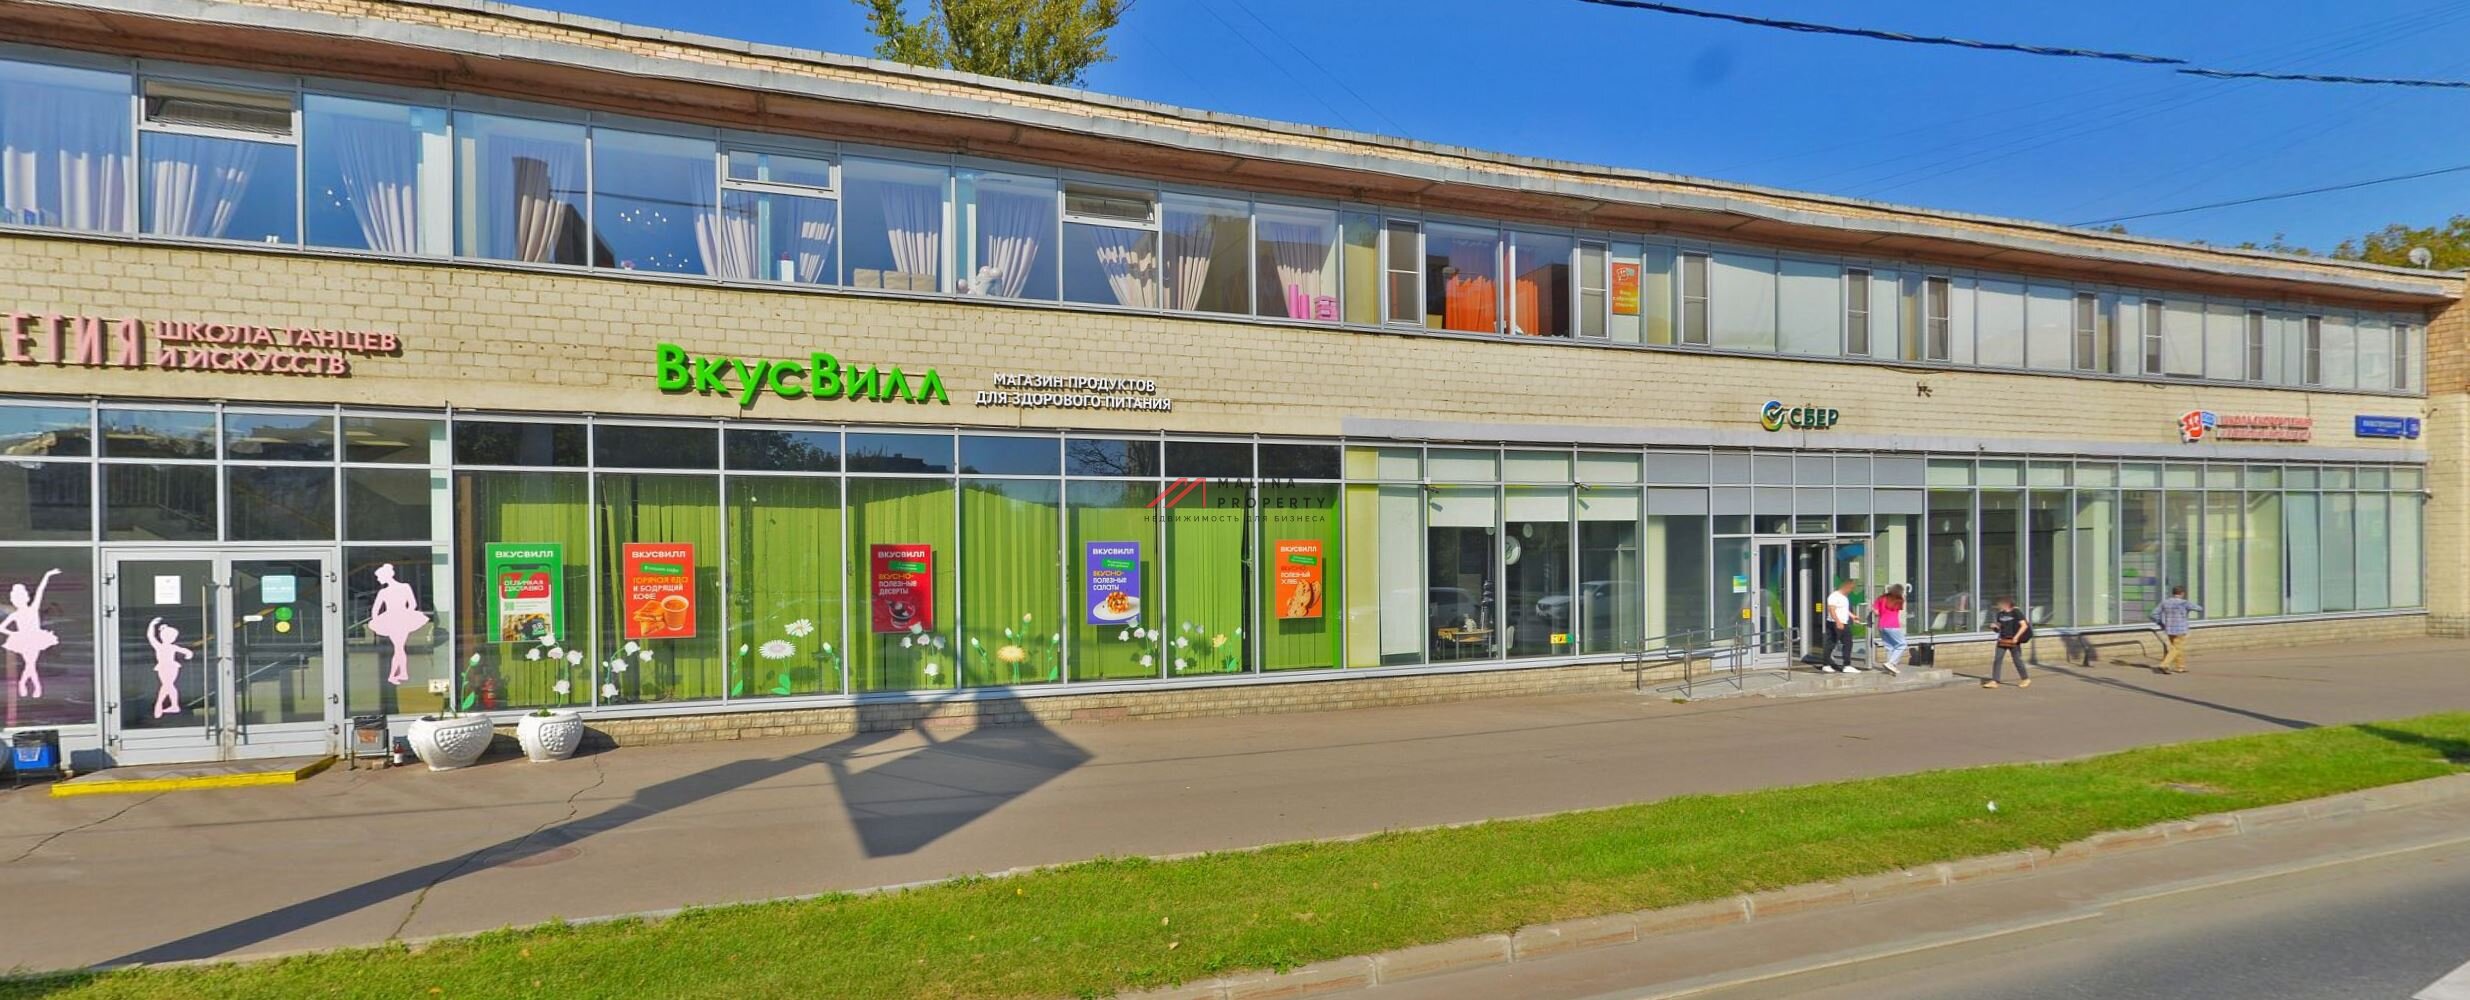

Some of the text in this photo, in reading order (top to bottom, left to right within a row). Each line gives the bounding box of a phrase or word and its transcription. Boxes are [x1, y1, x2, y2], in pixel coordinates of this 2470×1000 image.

[155, 319, 399, 354] ШКОЛА ТАНЦЕВ
[155, 346, 348, 376] И ИСКУССТВ
[656, 342, 951, 408] ВкусВилл
[993, 372, 1157, 395] МАГАЗИН ПРОДУКТОВ
[975, 389, 1173, 413] ДЛЯ ЗДОРОВОГО ПИТАНИЯ
[1788, 407, 1839, 427] СБЕР
